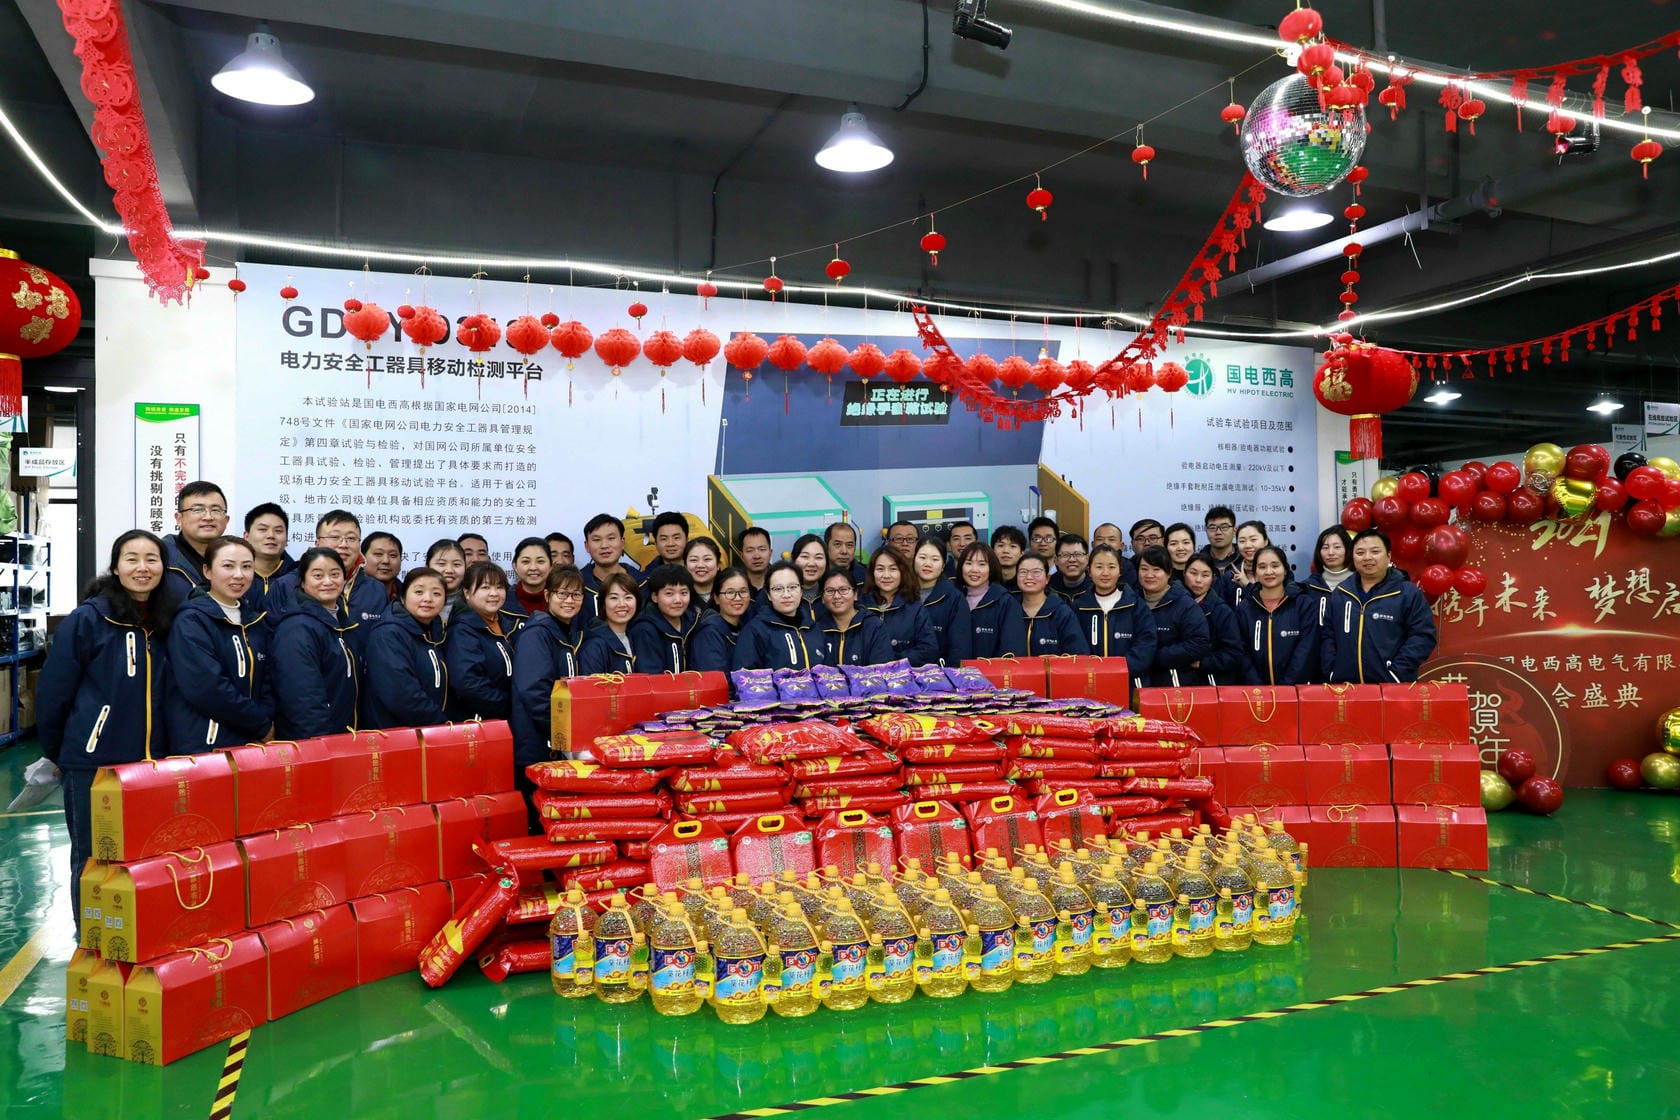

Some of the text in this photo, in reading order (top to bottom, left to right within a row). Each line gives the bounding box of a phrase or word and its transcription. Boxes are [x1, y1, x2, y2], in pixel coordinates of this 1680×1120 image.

[281, 350, 544, 381] 电力安全工器具移动检测平台
[1227, 364, 1294, 388] 国电西高
[1240, 388, 1260, 397] HIPOT
[1261, 390, 1294, 399] ELECTRIC
[1206, 417, 1293, 432] 试验车试验项目及范围
[150, 445, 163, 532] 没有挑剔的顾客
[1551, 682, 1644, 709] 会盛典
